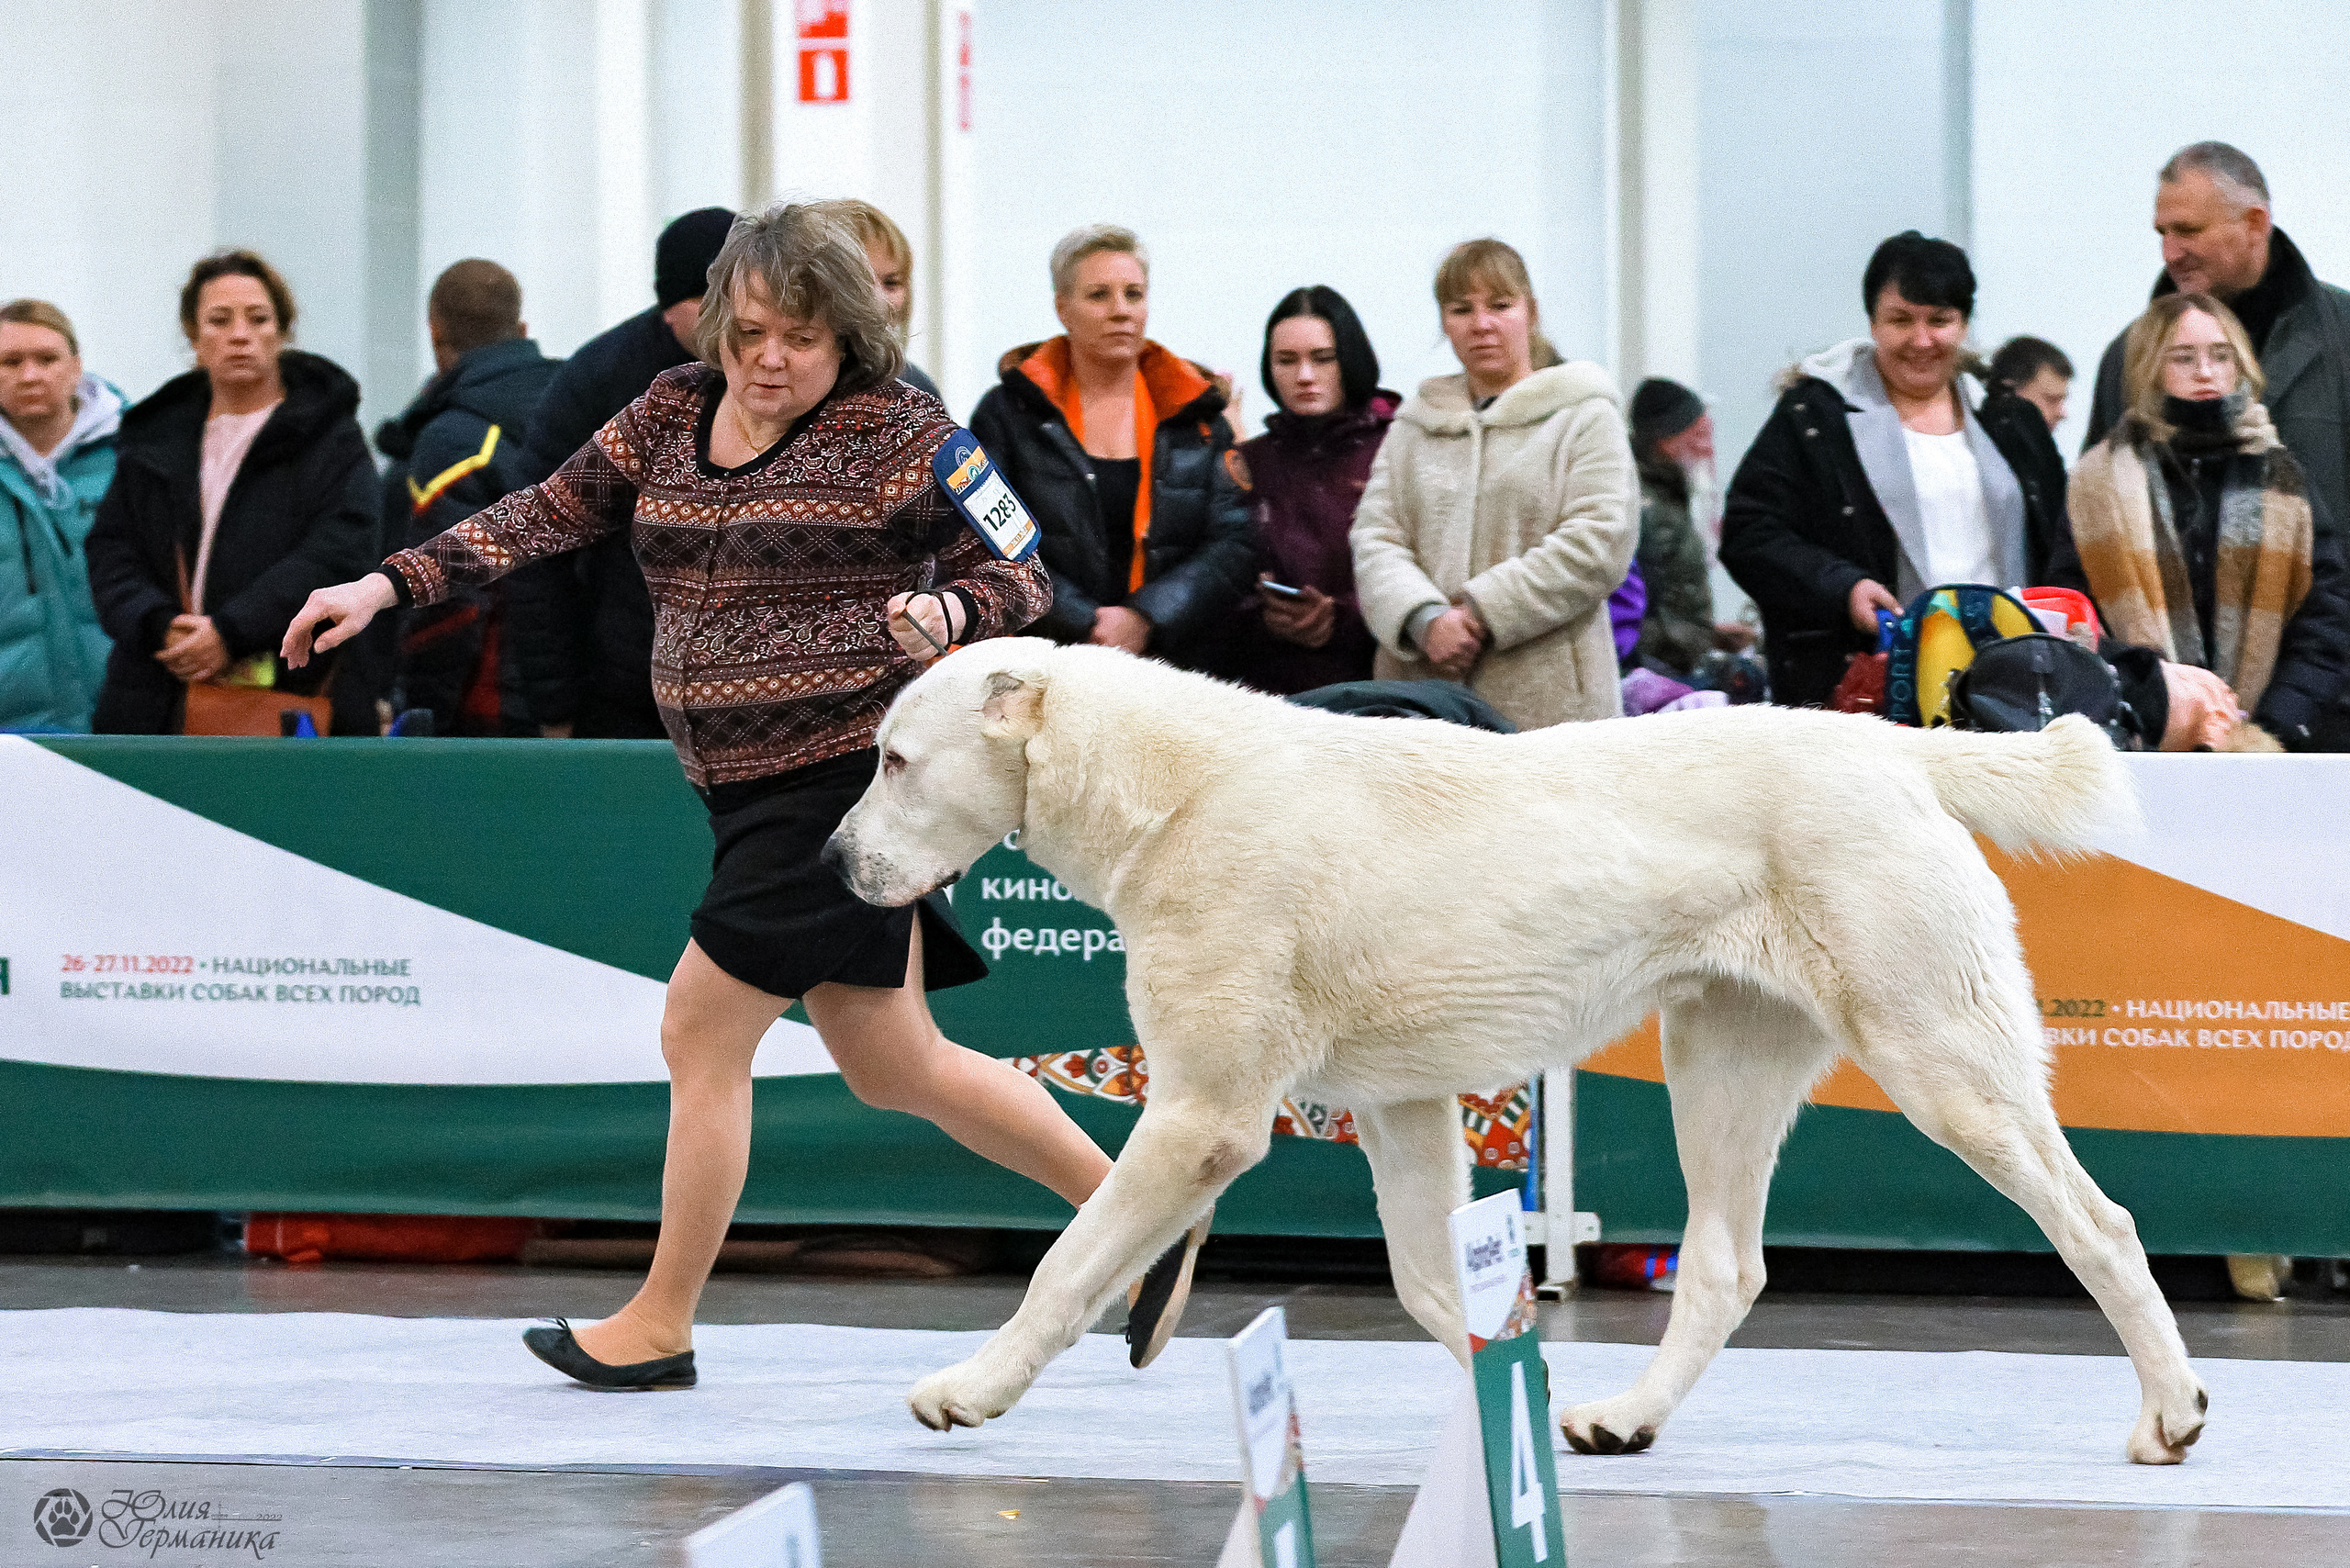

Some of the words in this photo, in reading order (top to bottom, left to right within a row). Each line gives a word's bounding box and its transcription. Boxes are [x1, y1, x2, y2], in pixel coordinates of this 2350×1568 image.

[983, 493, 1016, 532] 1283
[61, 953, 194, 974] 26-27.11.2022
[212, 957, 411, 977] НАЦИОНАЛЬНЫЕ
[60, 981, 185, 1000] ВЫСТАВКИ
[191, 982, 268, 1002] СОБАК
[275, 984, 333, 1002] ВСЕХ
[339, 985, 421, 1006] ПОРОД
[2126, 1000, 2350, 1021] НАЦИОНАЛЬНЫЕ
[2103, 1027, 2191, 1047] СОБАК
[2198, 1028, 2263, 1049] ВСЕХ
[1511, 1361, 1549, 1562] 4
